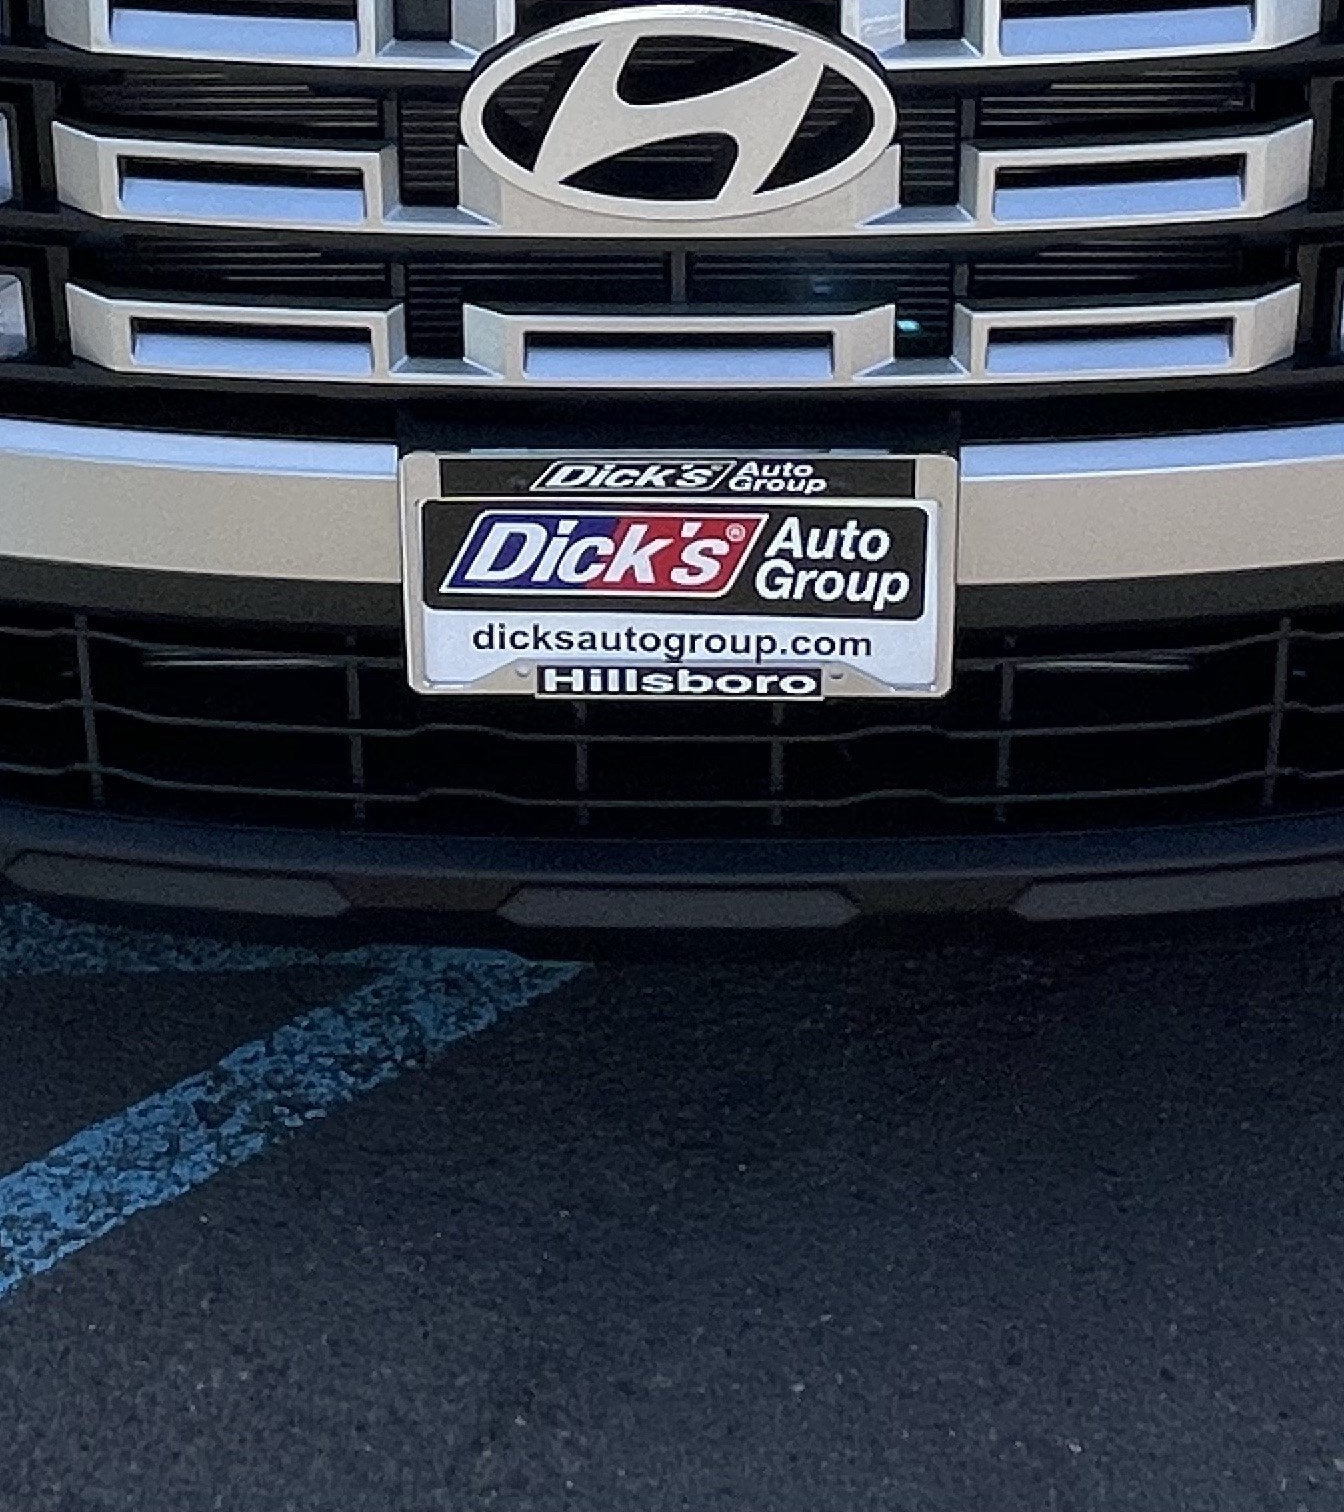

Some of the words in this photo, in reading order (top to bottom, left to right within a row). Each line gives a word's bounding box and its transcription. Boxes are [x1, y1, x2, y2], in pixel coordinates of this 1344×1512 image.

[728, 476, 828, 494] Group
[736, 461, 814, 477] Auto
[764, 516, 891, 560] Auto
[755, 559, 910, 611] Group
[472, 624, 872, 662] dicksautogroup.com
[543, 668, 817, 694] Hillsboro
